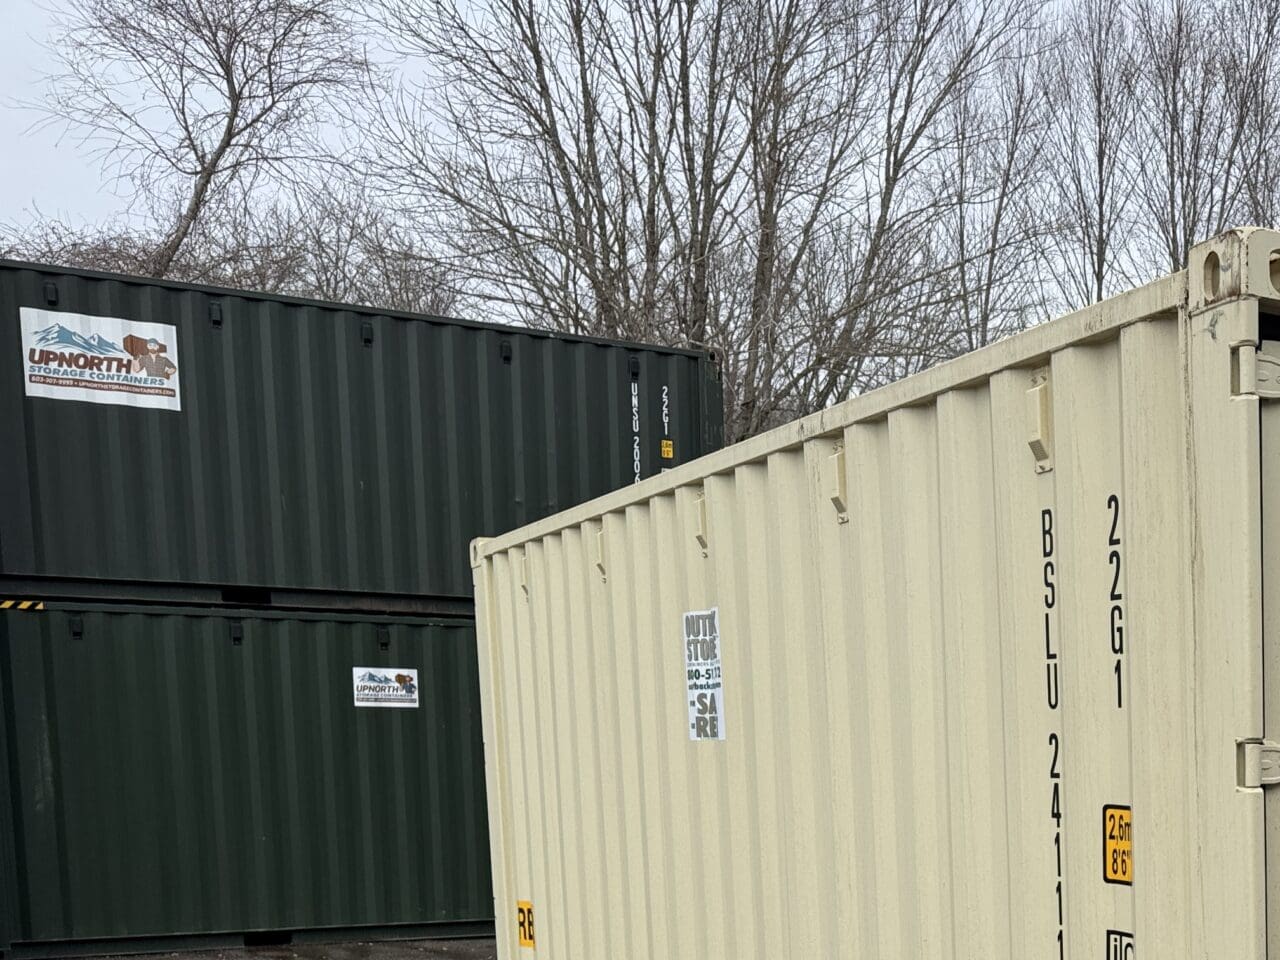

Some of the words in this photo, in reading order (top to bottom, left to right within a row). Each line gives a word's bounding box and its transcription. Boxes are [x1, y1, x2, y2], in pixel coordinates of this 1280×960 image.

[28, 348, 132, 374] UPNORTH
[28, 365, 86, 379] STORAGE
[89, 369, 165, 387] CONTAINERS
[1041, 508, 1058, 710] BSLU
[1107, 494, 1124, 708] 22G1
[356, 684, 399, 693] UPNORTH
